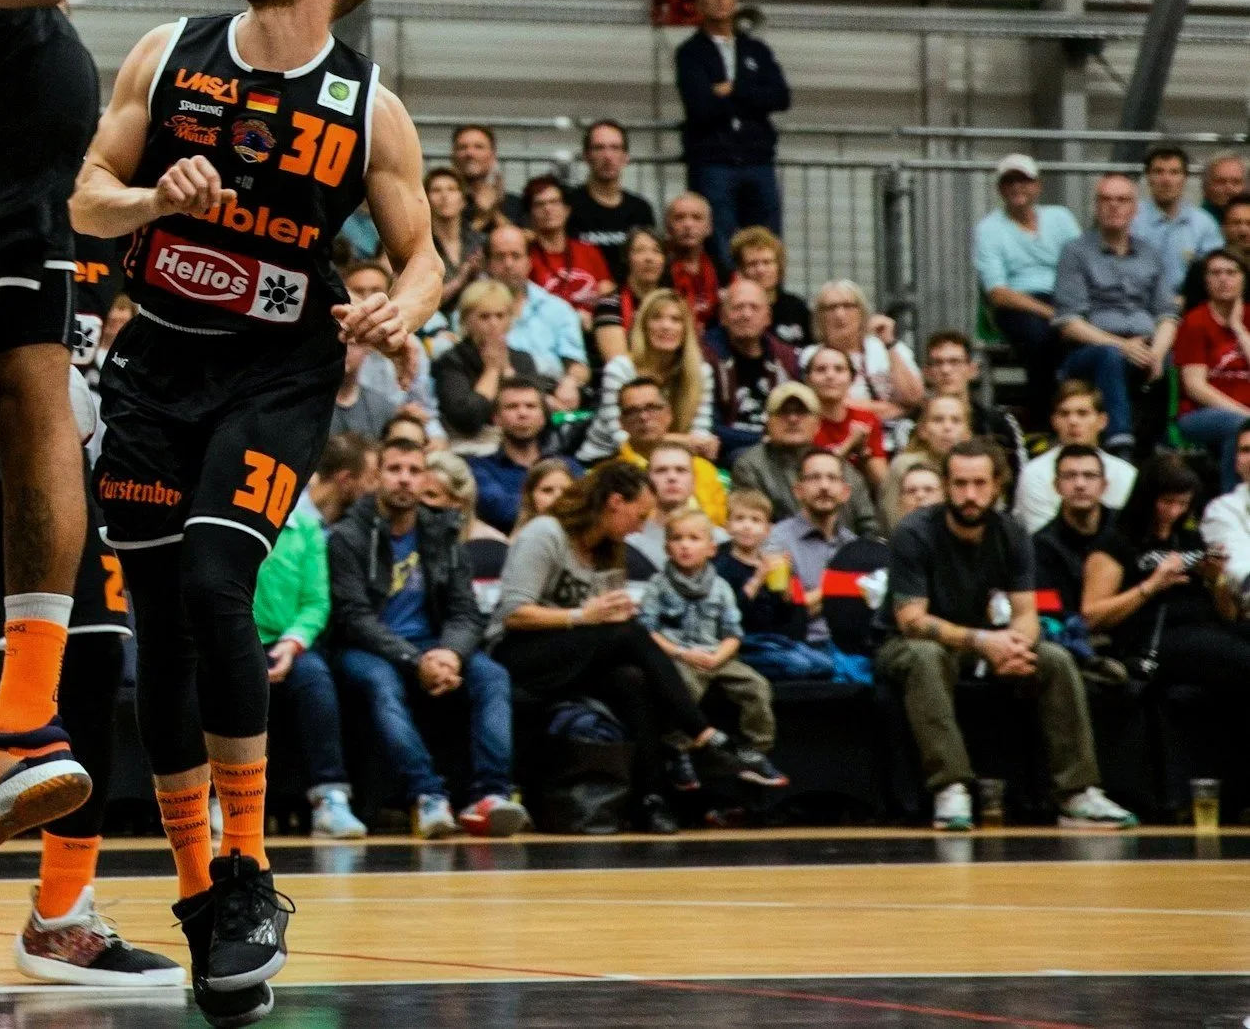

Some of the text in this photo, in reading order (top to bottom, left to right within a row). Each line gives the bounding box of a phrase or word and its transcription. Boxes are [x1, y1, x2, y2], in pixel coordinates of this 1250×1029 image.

[178, 99, 224, 118] SPALDING
[278, 110, 358, 188] 30
[154, 247, 250, 296] Helios
[232, 449, 298, 530] 30
